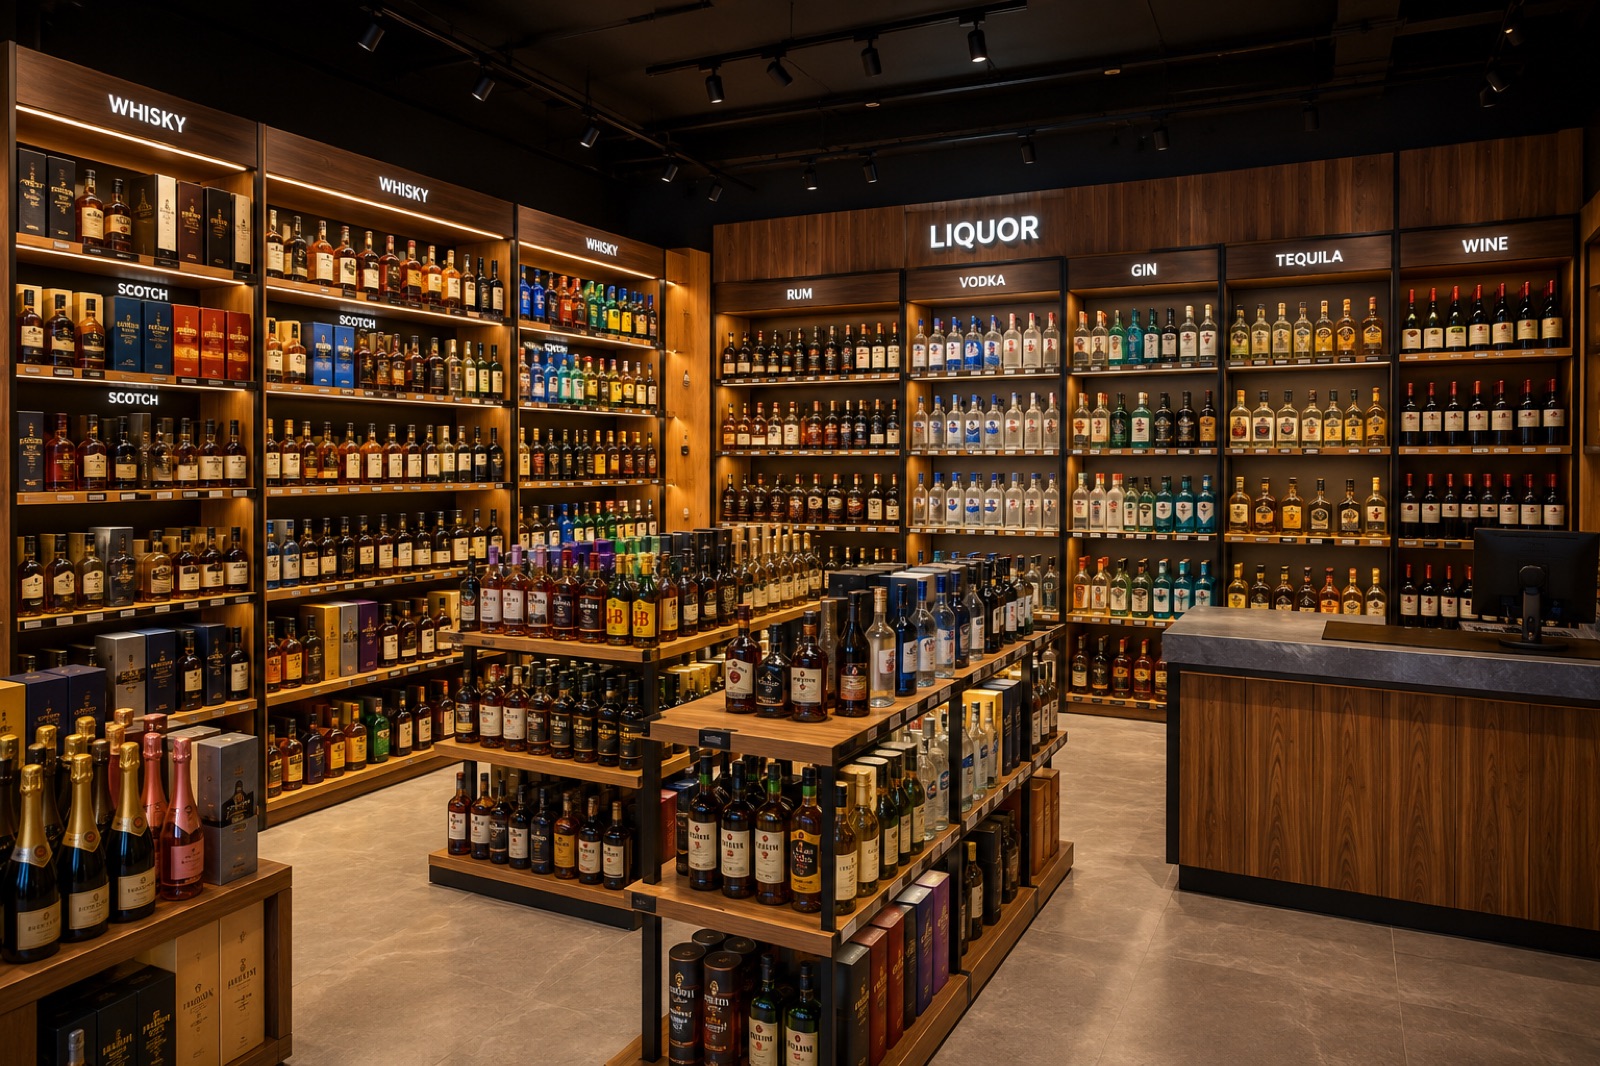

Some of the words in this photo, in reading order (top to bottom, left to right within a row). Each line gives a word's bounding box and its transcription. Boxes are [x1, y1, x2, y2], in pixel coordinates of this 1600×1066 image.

[107, 93, 187, 134] WHISKY
[378, 176, 429, 204] WHISKY
[930, 215, 1040, 249] LIQUOR
[585, 237, 619, 257] WHISKY
[1461, 236, 1509, 254] WINE
[1275, 249, 1344, 267] TEQUILA
[1131, 262, 1158, 277] GIN
[959, 274, 1006, 289] VODKA
[117, 282, 169, 302] SCOTCH
[786, 287, 813, 301] RUM
[338, 314, 377, 330] SCOTCH
[108, 390, 160, 406] SCOTCH
